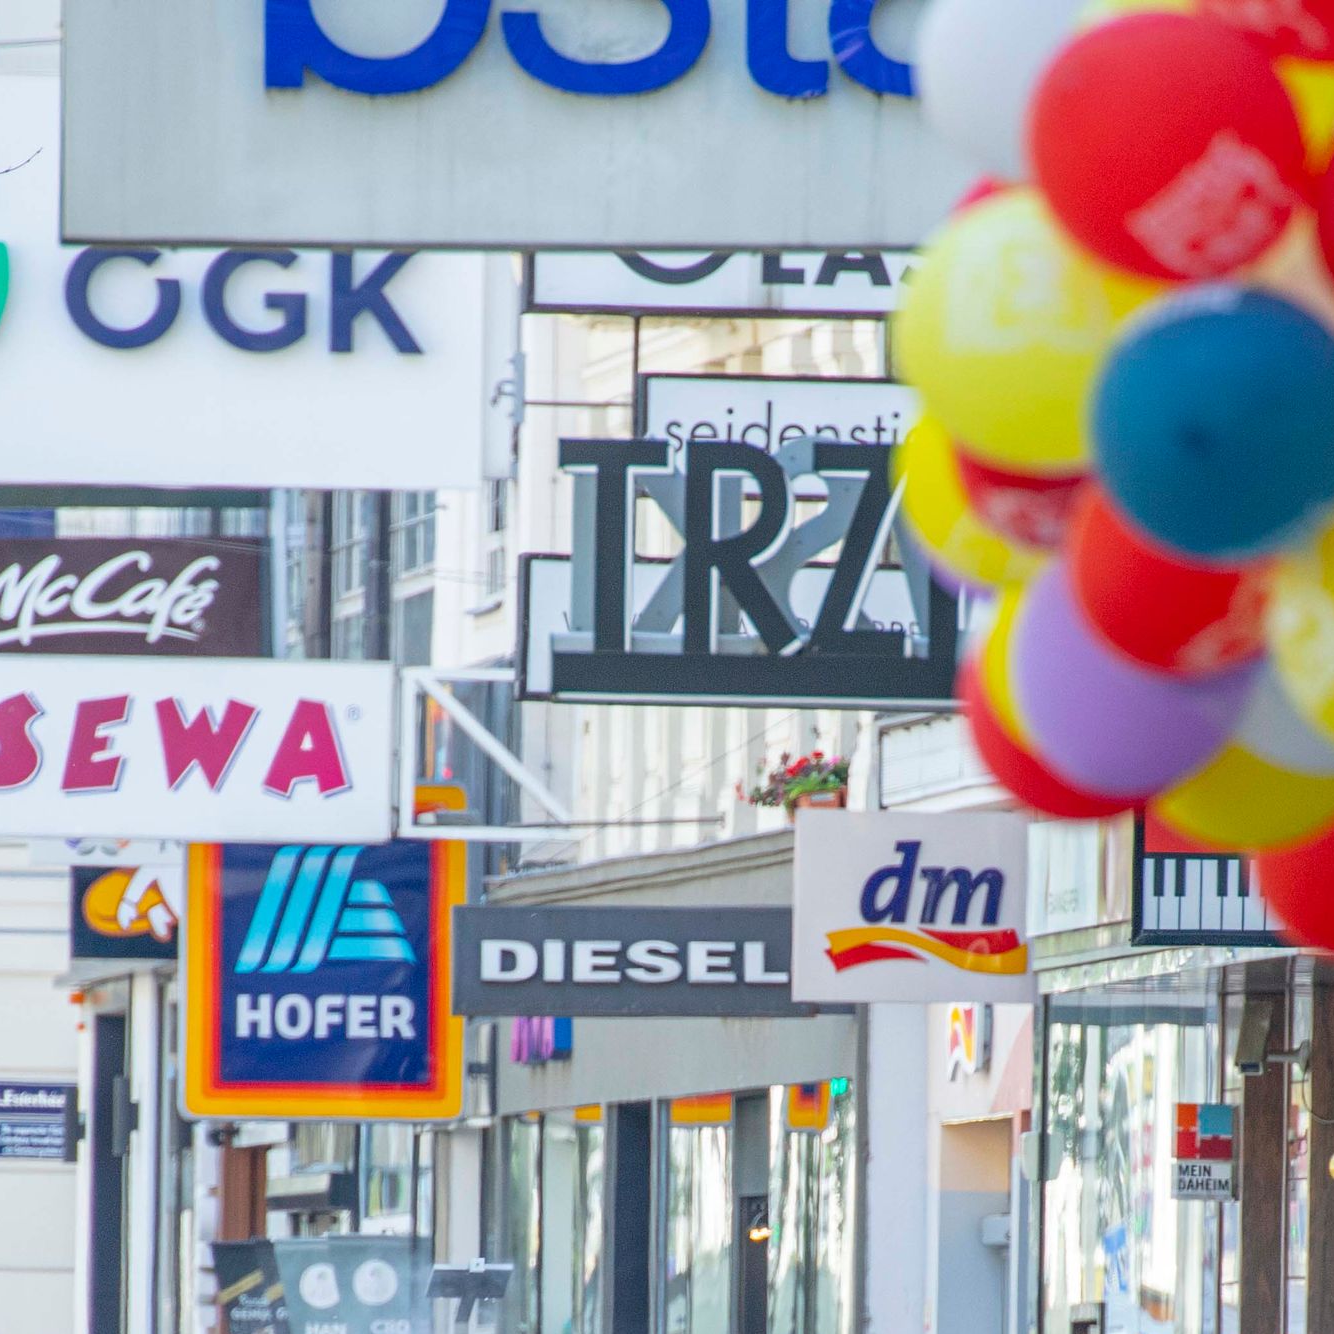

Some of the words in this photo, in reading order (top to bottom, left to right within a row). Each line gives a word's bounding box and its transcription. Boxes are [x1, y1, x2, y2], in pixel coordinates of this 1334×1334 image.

[666, 400, 903, 453] seidensti
[860, 840, 1005, 926] dm
[479, 938, 791, 985] DIESEL
[236, 993, 416, 1041] HOFER
[1178, 1164, 1212, 1178] MEIN
[1178, 1178, 1230, 1192] DAHEIM
